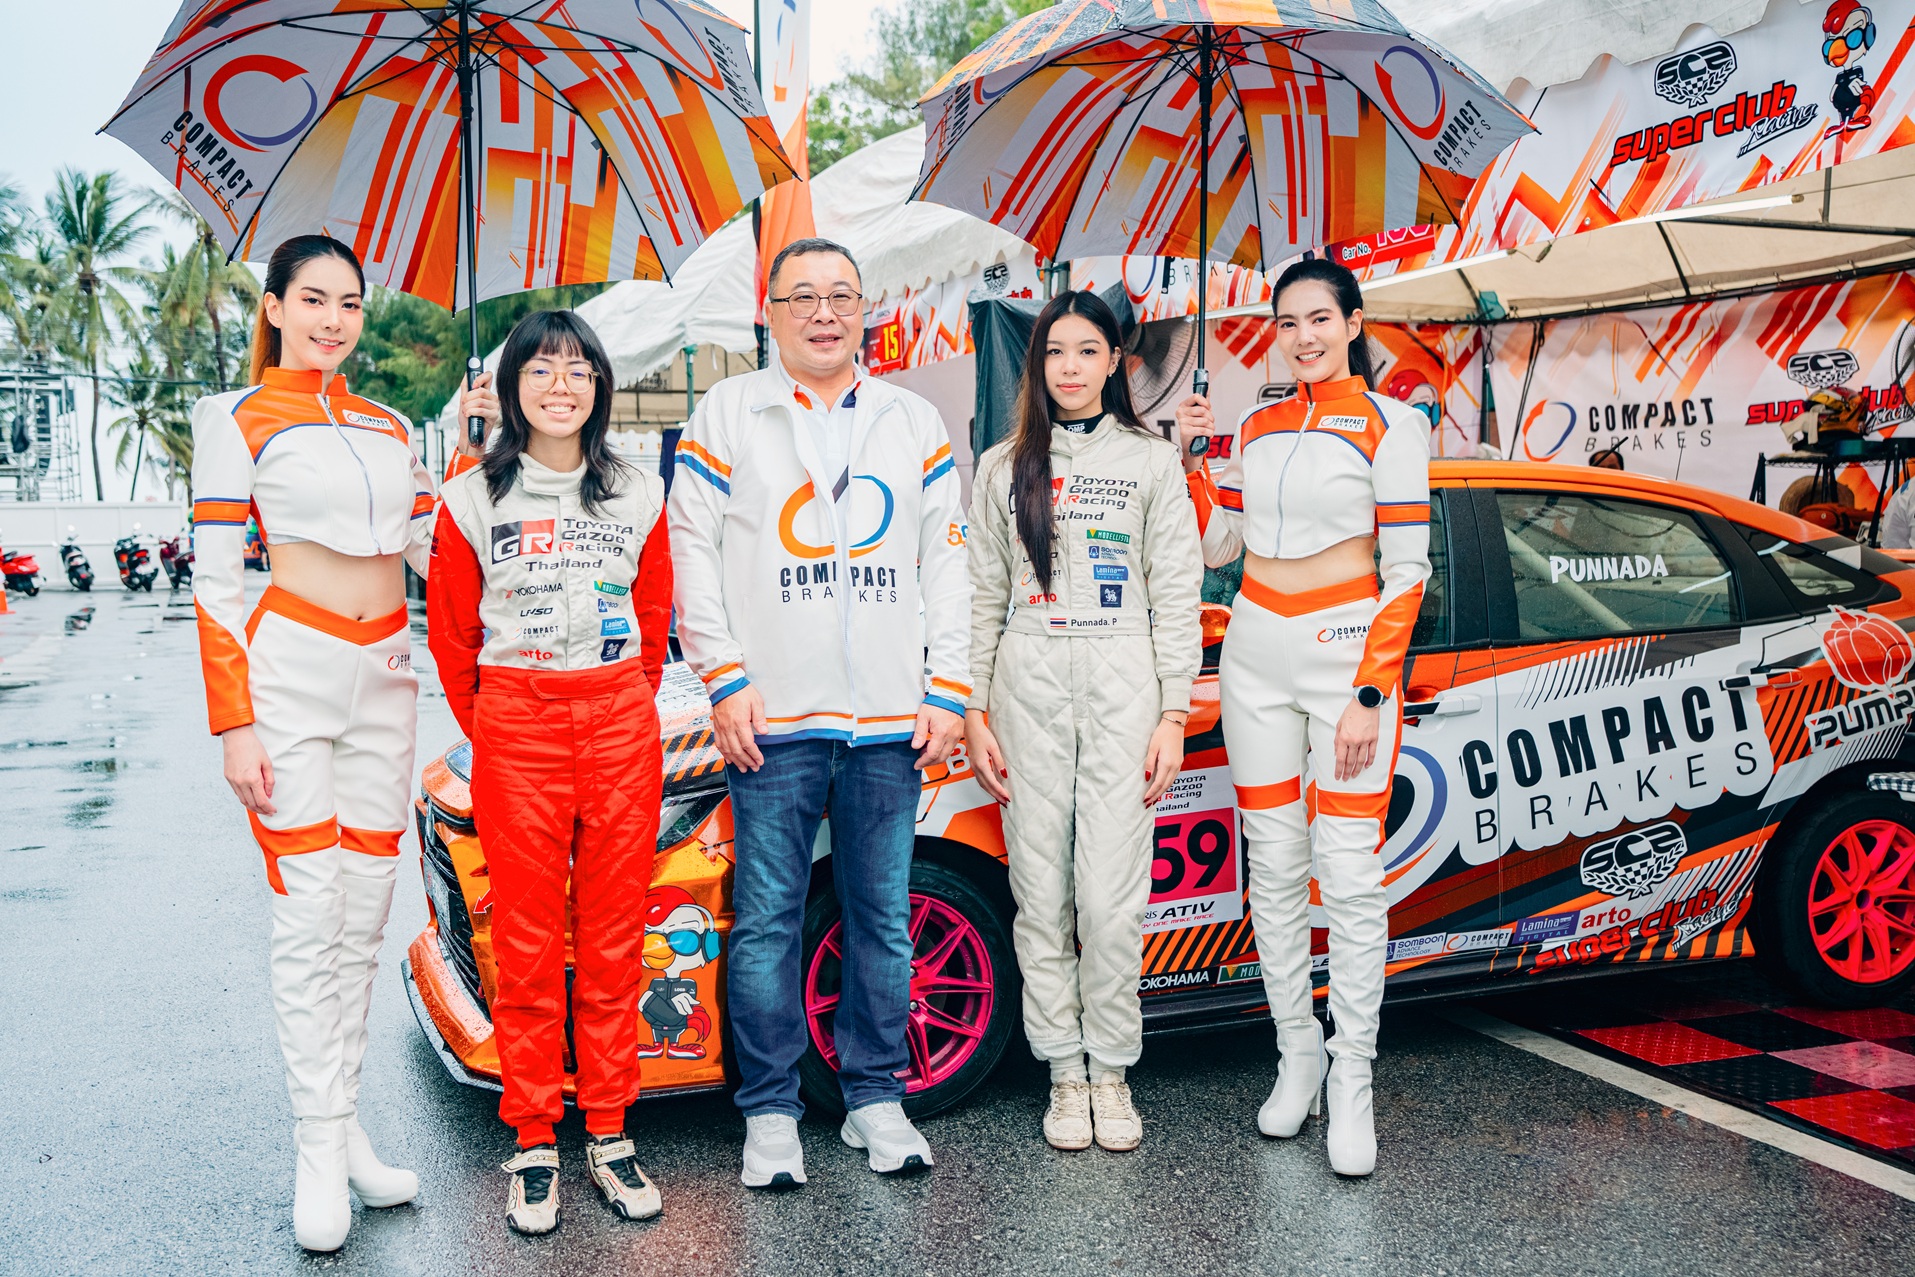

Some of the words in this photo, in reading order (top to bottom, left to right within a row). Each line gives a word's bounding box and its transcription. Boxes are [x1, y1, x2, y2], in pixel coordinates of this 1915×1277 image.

[1433, 100, 1483, 167] COMPACT
[1741, 103, 1819, 147] Racing
[173, 110, 254, 200] COMPACT
[1448, 119, 1492, 178] BRAKES
[160, 130, 235, 214] BRAKES
[1342, 246, 1356, 261] Car
[1356, 242, 1372, 257] No.
[883, 324, 899, 361] 15
[1588, 397, 1715, 433] COMPACT
[1072, 475, 1138, 489] TOYOTA
[1069, 485, 1129, 498] GAZOO
[1064, 495, 1126, 510] Racing
[1053, 511, 1104, 521] ailand
[563, 518, 633, 535] TOYOTA
[561, 530, 625, 544] GAZOO
[493, 532, 553, 562] GR
[559, 542, 623, 557] Racing
[525, 559, 603, 572] Thailand
[1549, 554, 1669, 584] PUNNADA
[514, 582, 563, 597] YOKOHAMA
[782, 586, 897, 603] BRAKES
[523, 625, 559, 635] COMPACT
[1112, 617, 1118, 626] P
[518, 648, 553, 661] arto
[1813, 686, 1915, 747] PUMP
[1462, 680, 1748, 799] COMPACT
[1173, 775, 1207, 785] OYOTA
[1165, 790, 1202, 800] Racing
[1475, 741, 1758, 844] BRAKES
[1156, 802, 1190, 812] ailand
[1150, 819, 1230, 894] 59
[1160, 901, 1215, 920] ATIV
[1581, 907, 1631, 929] arto
[1521, 918, 1560, 932] Lamina
[1471, 932, 1510, 942] COMPACT
[1518, 930, 1569, 942] DIGITAL
[1139, 971, 1210, 990] OKOHAMA
